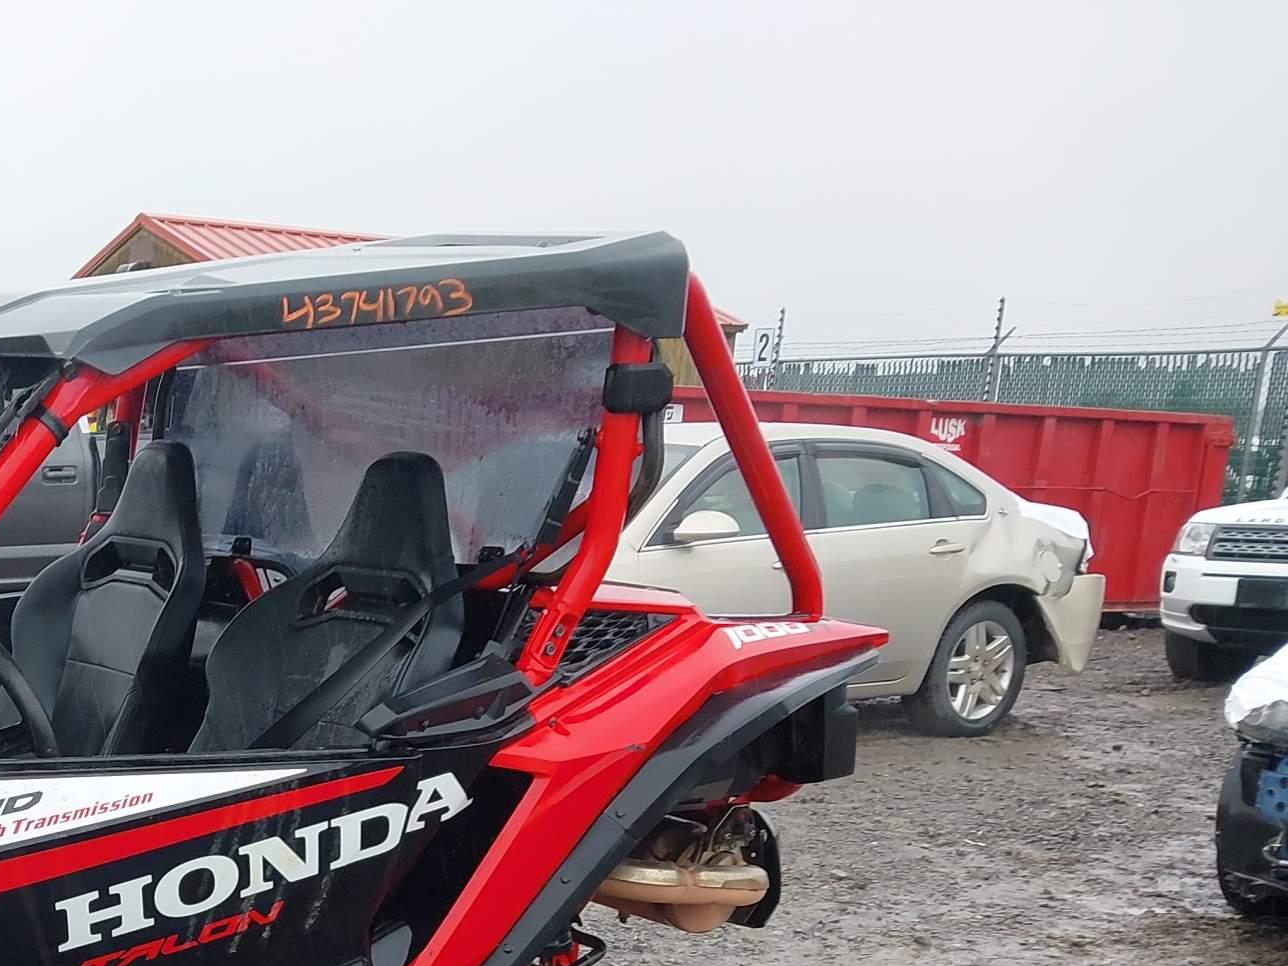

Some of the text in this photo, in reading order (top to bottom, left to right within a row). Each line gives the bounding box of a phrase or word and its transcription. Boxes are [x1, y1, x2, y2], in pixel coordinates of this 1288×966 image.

[281, 278, 473, 328] 43741793
[757, 333, 770, 362] 2
[930, 417, 967, 443] LUSK
[12, 792, 154, 834] Transmission
[55, 772, 474, 953] HONDA
